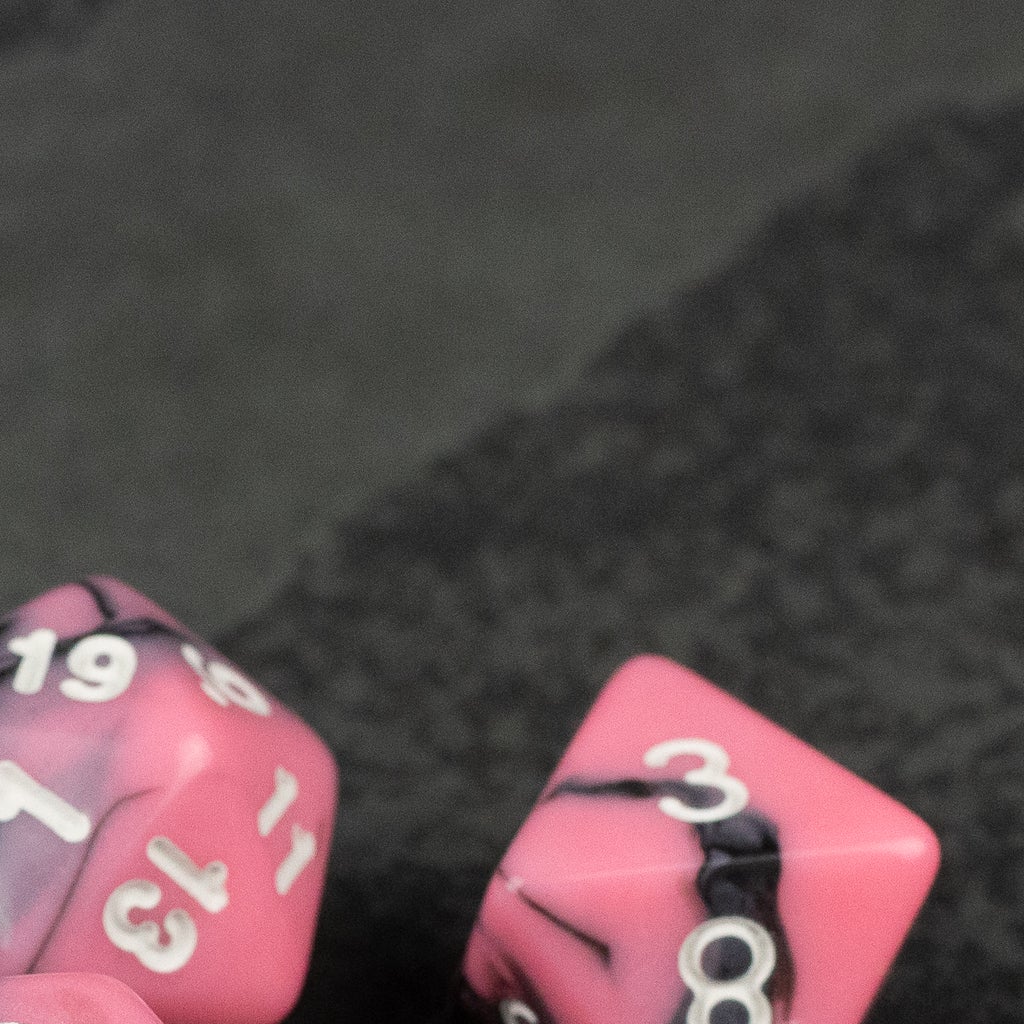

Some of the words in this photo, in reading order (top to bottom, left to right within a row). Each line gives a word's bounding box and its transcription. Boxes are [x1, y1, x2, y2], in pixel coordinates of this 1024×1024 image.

[7, 626, 139, 704] 19
[643, 737, 750, 824] 3
[102, 834, 230, 974] 13
